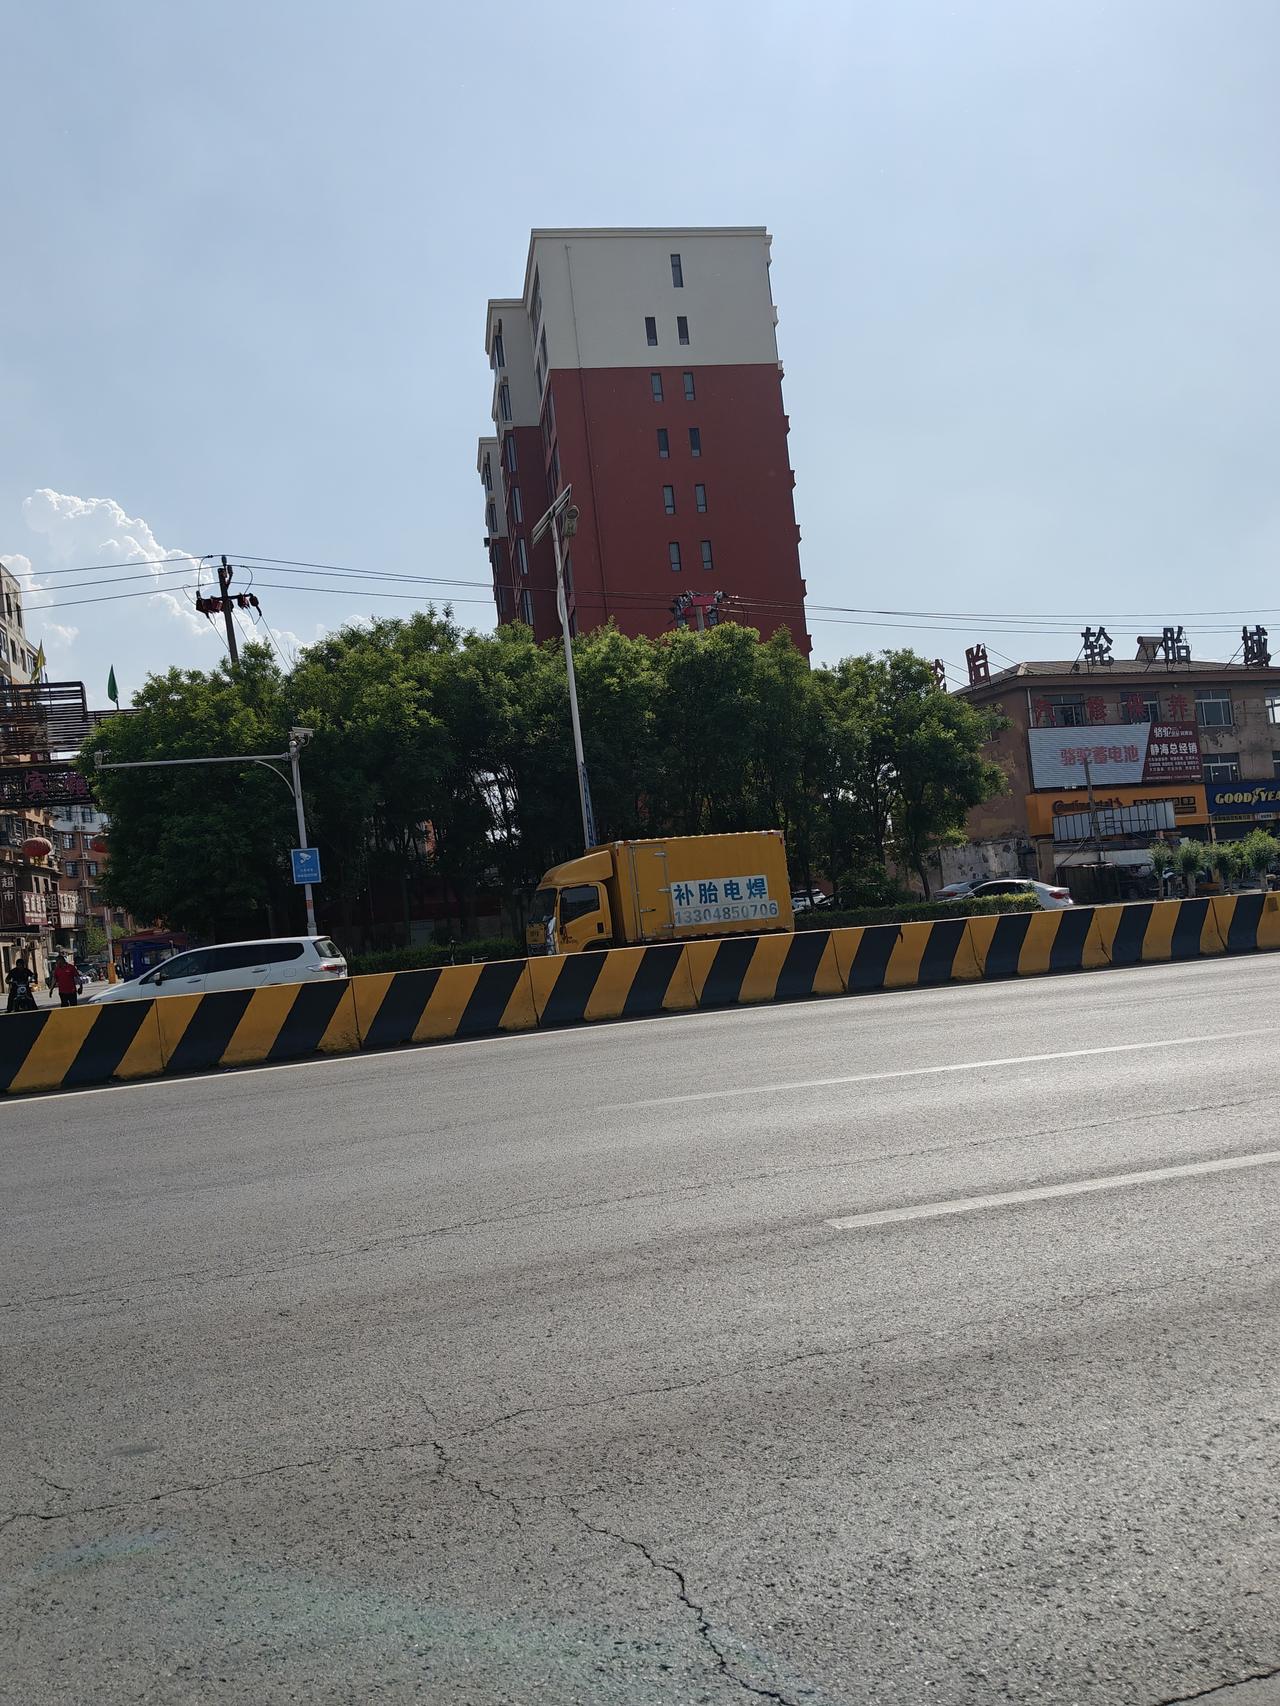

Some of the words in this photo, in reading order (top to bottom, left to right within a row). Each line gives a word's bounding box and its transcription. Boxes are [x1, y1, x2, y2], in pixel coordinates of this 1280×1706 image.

[1081, 625, 1272, 667] 轮胎城
[1060, 743, 1140, 767] 骆驼蓄电池
[1150, 742, 1198, 756] 静海总经销
[1, 876, 15, 902] 超市
[674, 878, 768, 906] 补胎电焊
[45, 893, 59, 925] 超市
[674, 901, 778, 924] 13304850706
